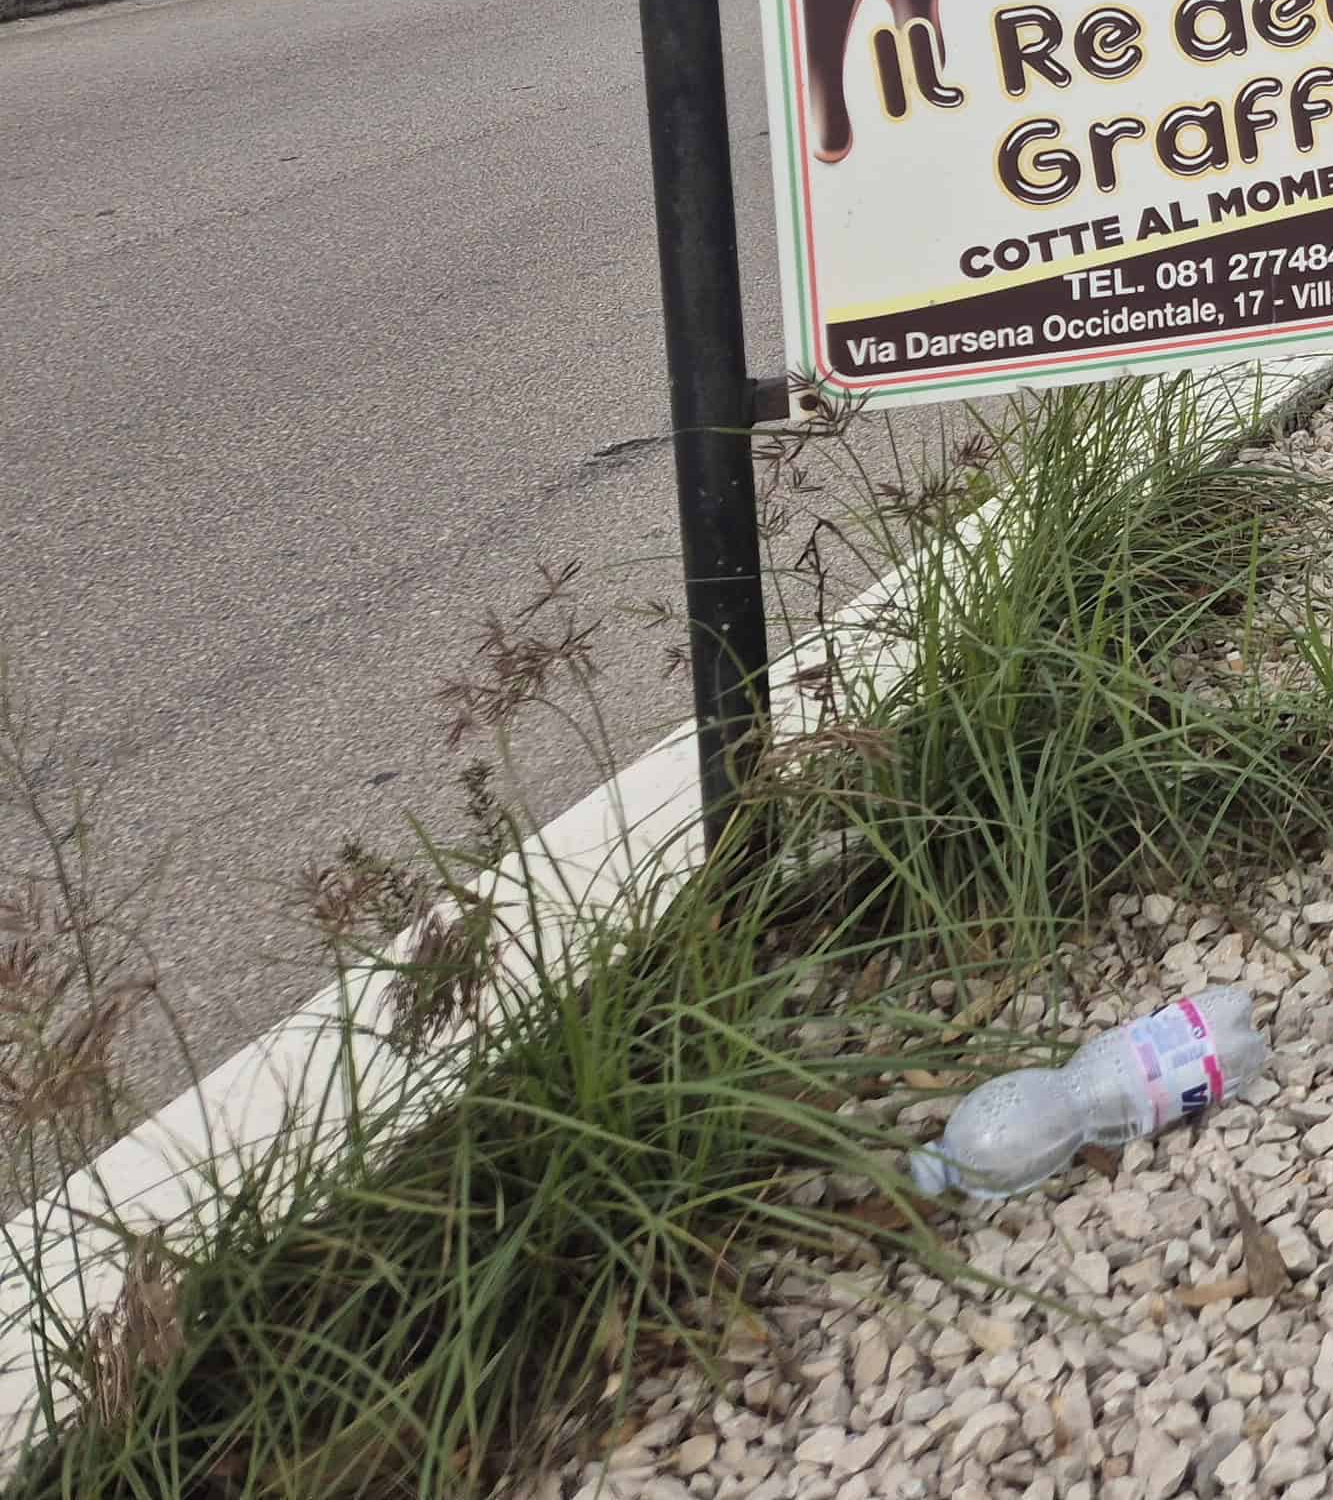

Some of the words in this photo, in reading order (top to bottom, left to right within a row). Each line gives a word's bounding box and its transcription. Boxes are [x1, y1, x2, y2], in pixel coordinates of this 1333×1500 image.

[993, 1, 1145, 100] Re
[959, 215, 1125, 279] COTTE
[1135, 202, 1200, 241] AL
[1063, 270, 1145, 302] TEL.
[1156, 257, 1215, 290] 081
[846, 336, 897, 367] Via
[906, 325, 1035, 360] Darsena
[1042, 297, 1226, 341] Occidentale,
[1233, 289, 1264, 317] 17
